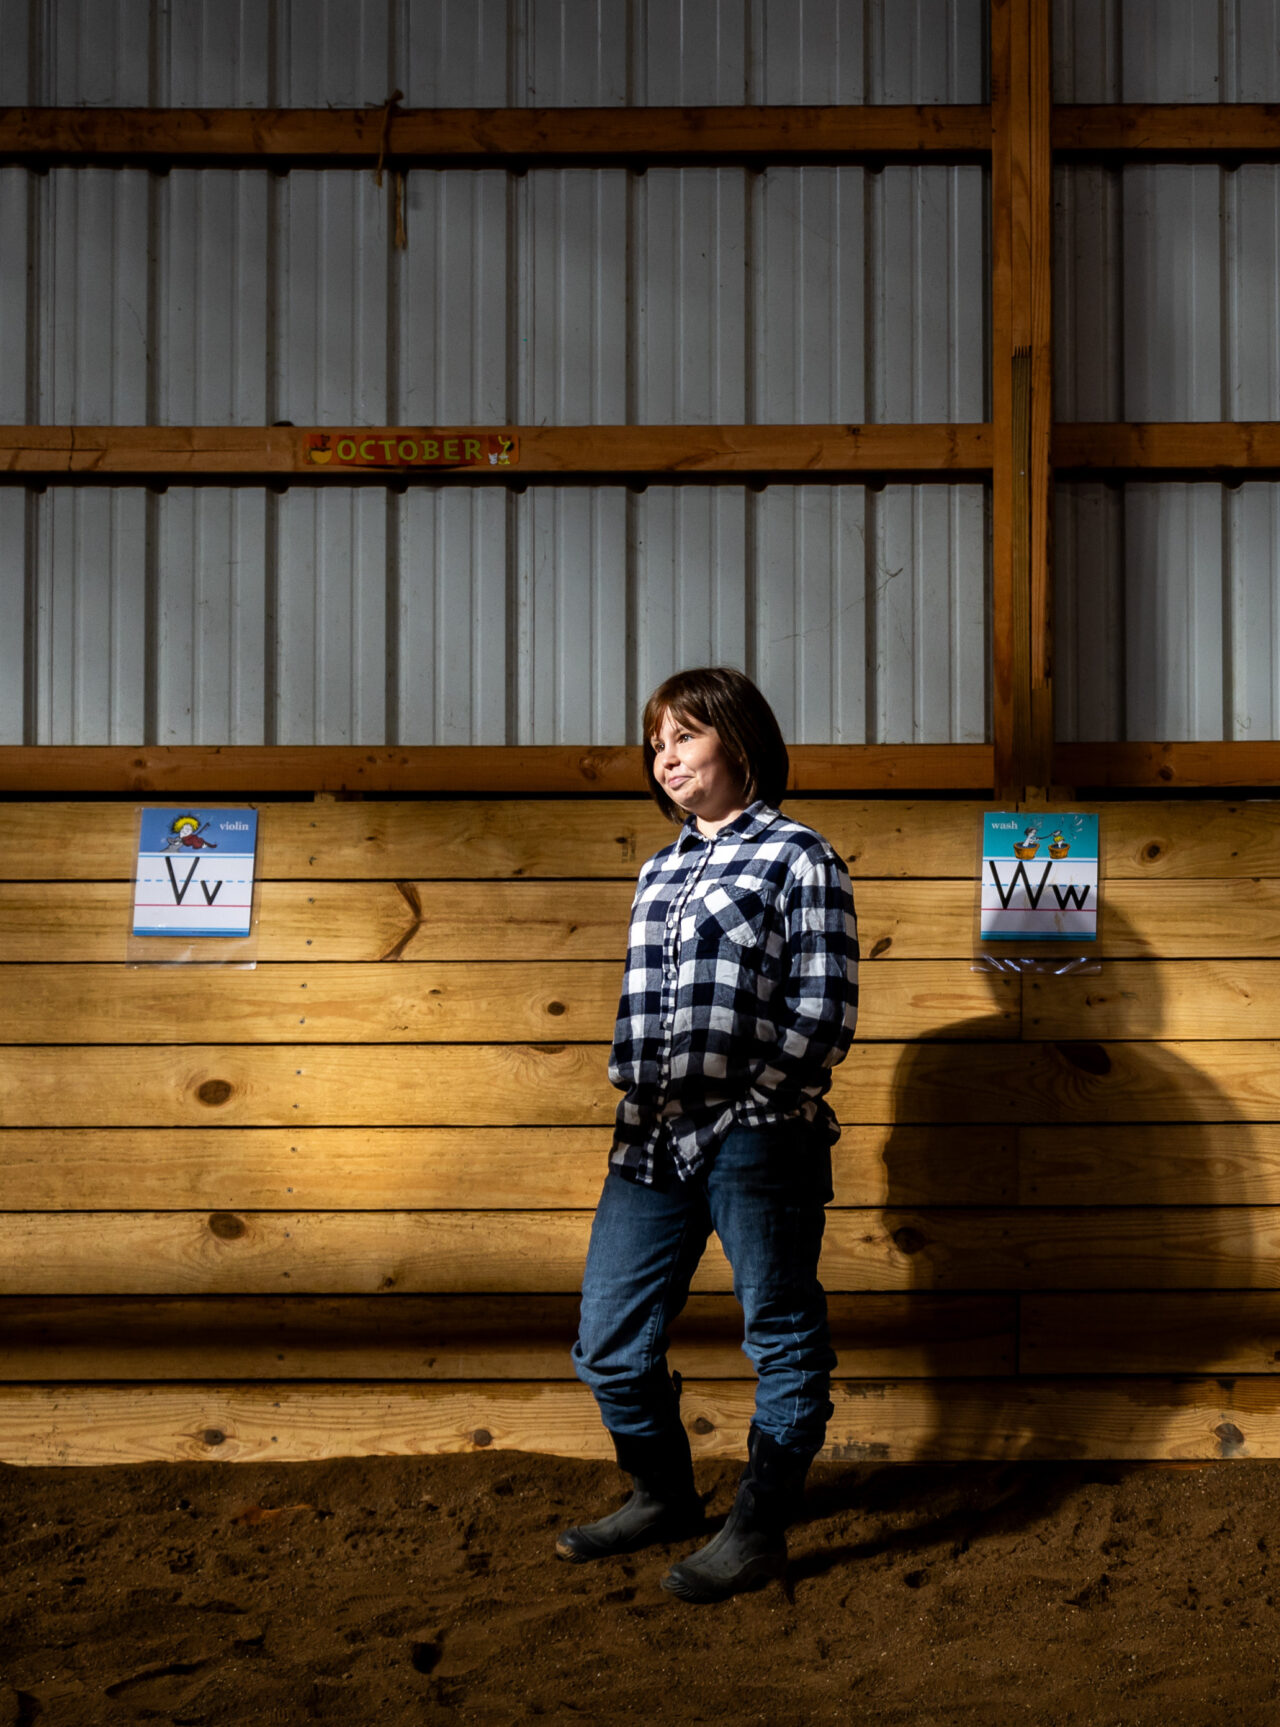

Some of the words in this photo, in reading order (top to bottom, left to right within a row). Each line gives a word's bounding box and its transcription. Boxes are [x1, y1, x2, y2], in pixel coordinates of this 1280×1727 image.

[337, 439, 483, 461] OCTOBER
[219, 821, 249, 831] violin
[991, 820, 1018, 830] wash
